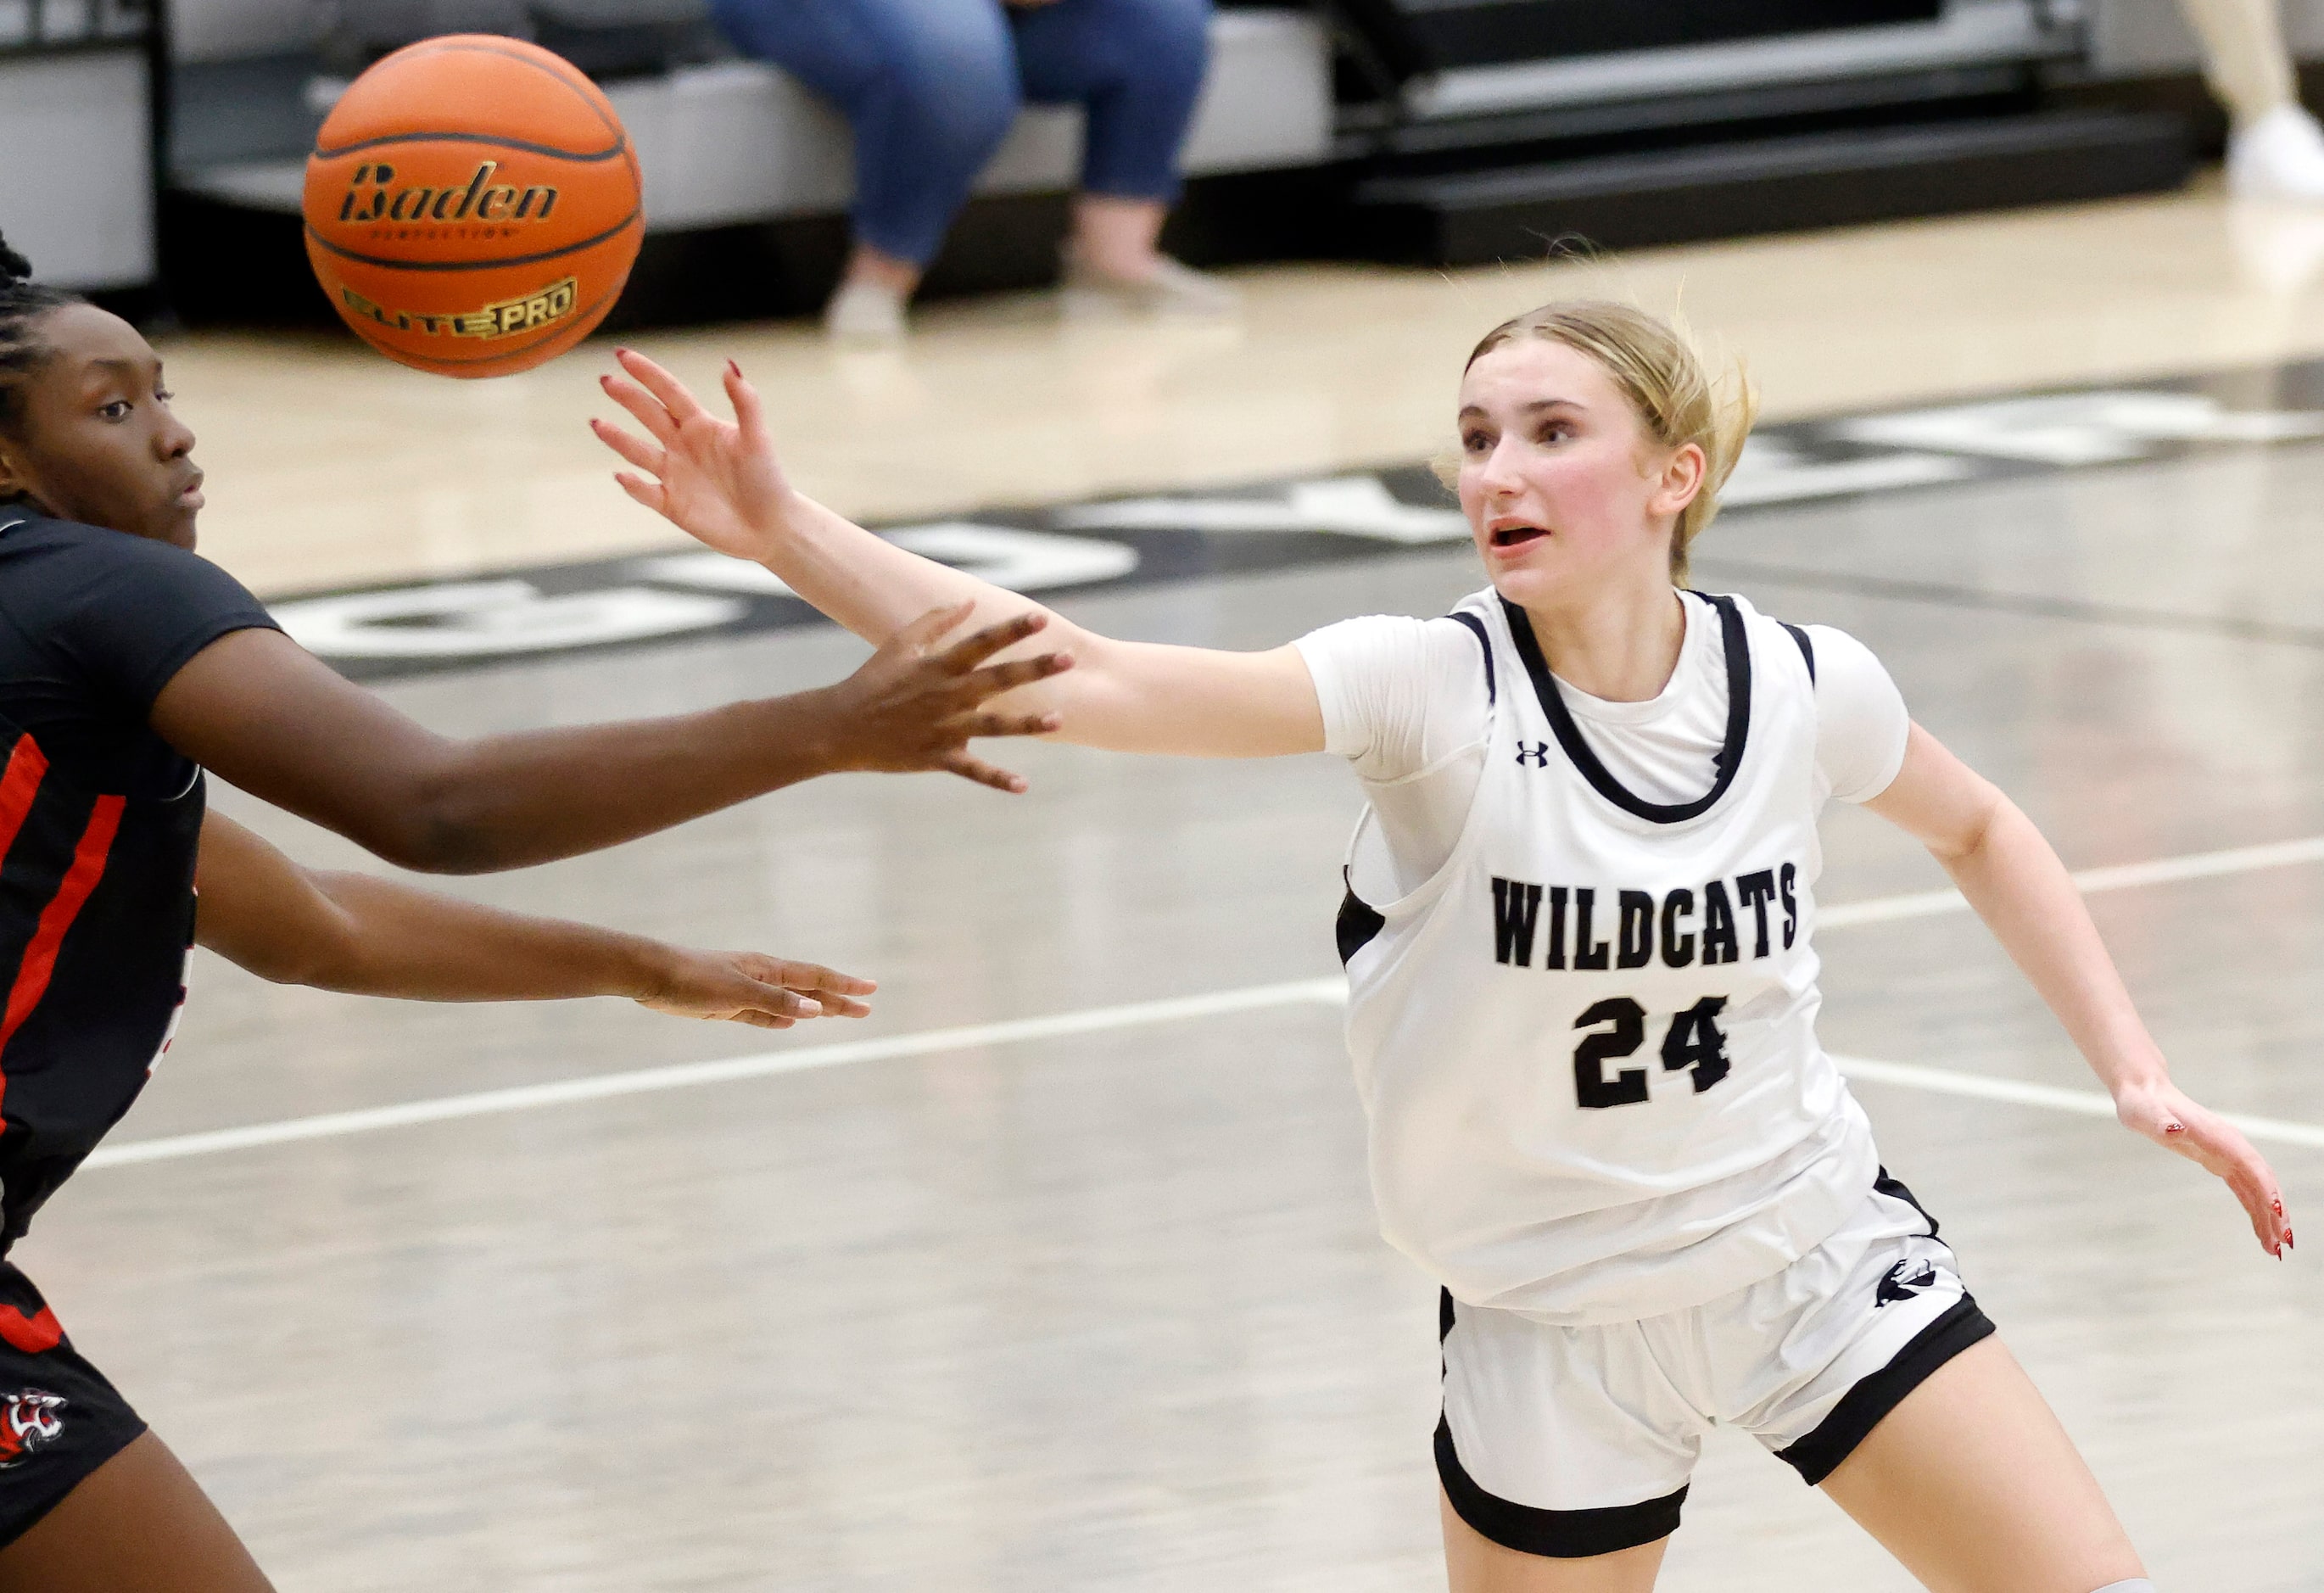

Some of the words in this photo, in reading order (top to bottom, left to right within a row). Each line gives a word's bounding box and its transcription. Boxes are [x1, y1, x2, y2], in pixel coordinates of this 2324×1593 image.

[339, 161, 558, 222] Baden
[342, 286, 499, 339] ELITE
[500, 283, 572, 333] PRO
[1490, 860, 1797, 972] WILDCATS
[1572, 993, 1732, 1110] 24
